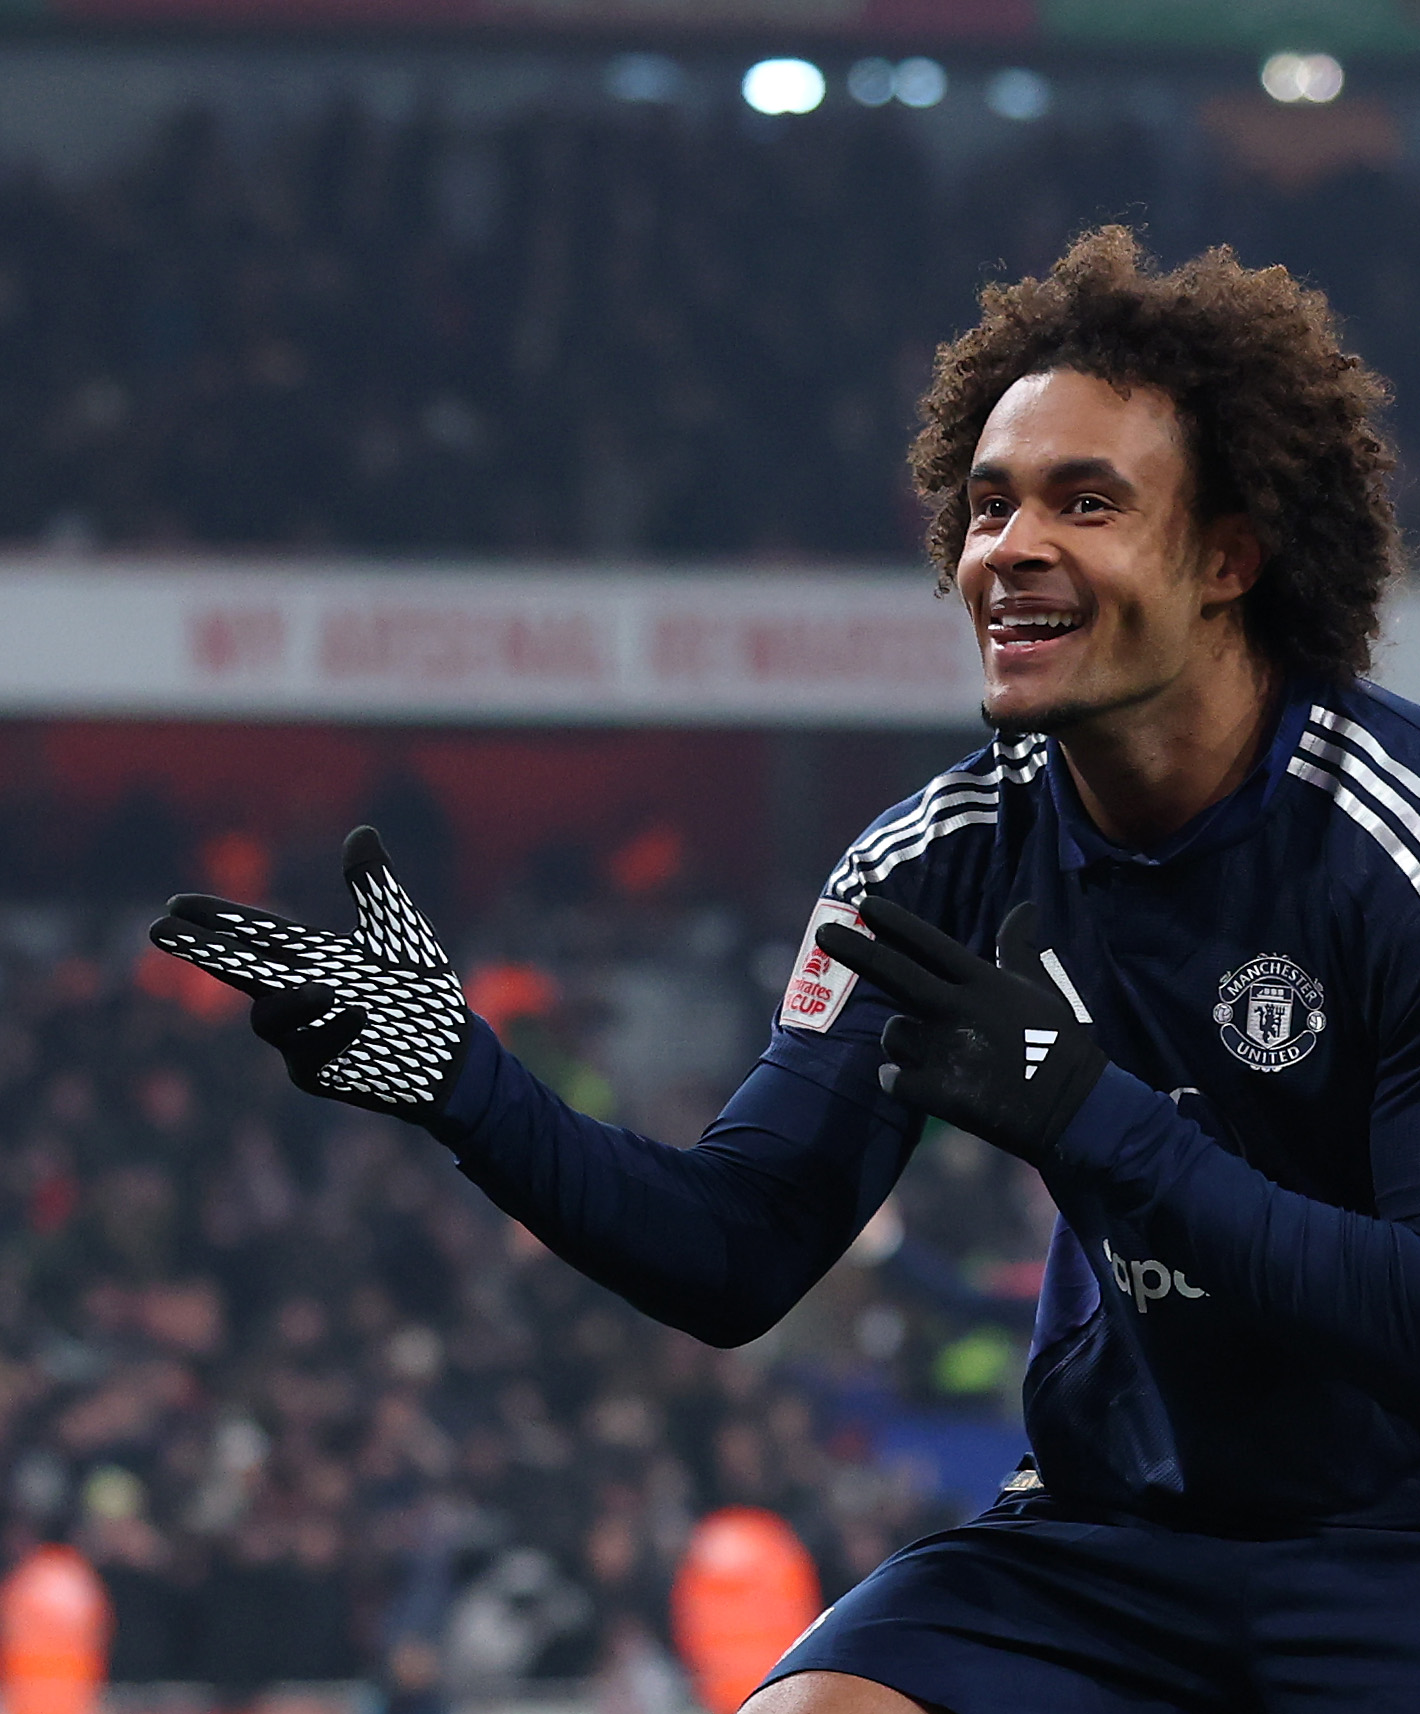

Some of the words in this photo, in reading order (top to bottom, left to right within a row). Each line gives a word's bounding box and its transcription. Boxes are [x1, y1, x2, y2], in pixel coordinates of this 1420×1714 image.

[1226, 961, 1319, 1004] MANCHESTER
[790, 993, 827, 1016] CUP
[1236, 1041, 1301, 1064] UNITED
